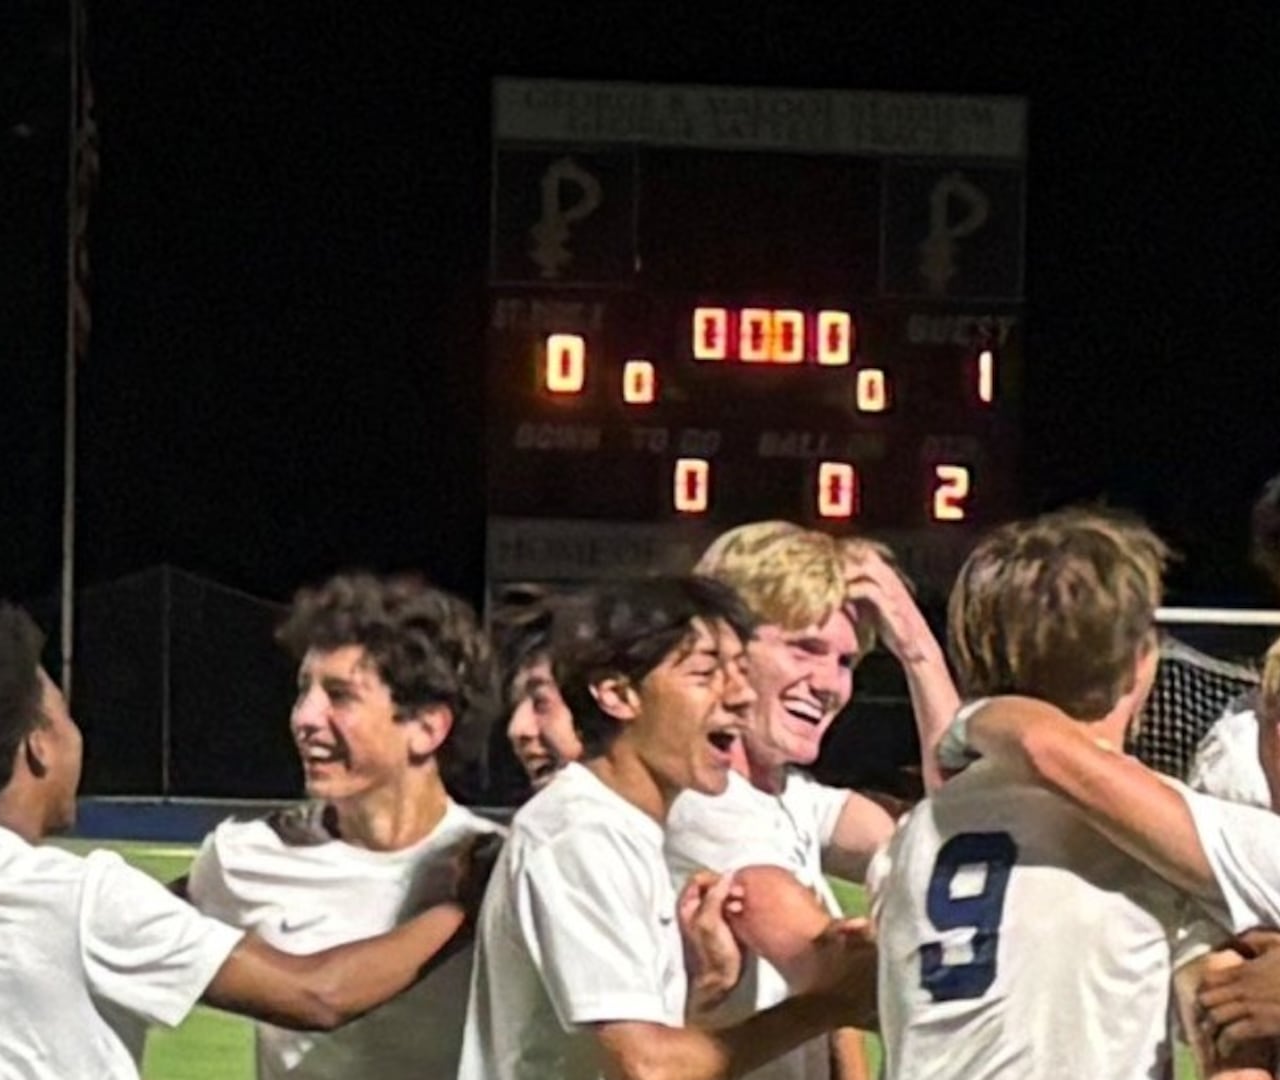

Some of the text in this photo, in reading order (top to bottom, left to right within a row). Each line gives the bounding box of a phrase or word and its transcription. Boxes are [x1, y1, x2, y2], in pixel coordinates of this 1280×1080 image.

[545, 333, 586, 394] 0
[622, 360, 656, 405] 0
[855, 367, 888, 413] 0
[977, 349, 995, 404] 1
[673, 458, 710, 513] 0
[817, 461, 855, 518] 0
[932, 465, 971, 521] 2
[919, 831, 1019, 1004] 9
